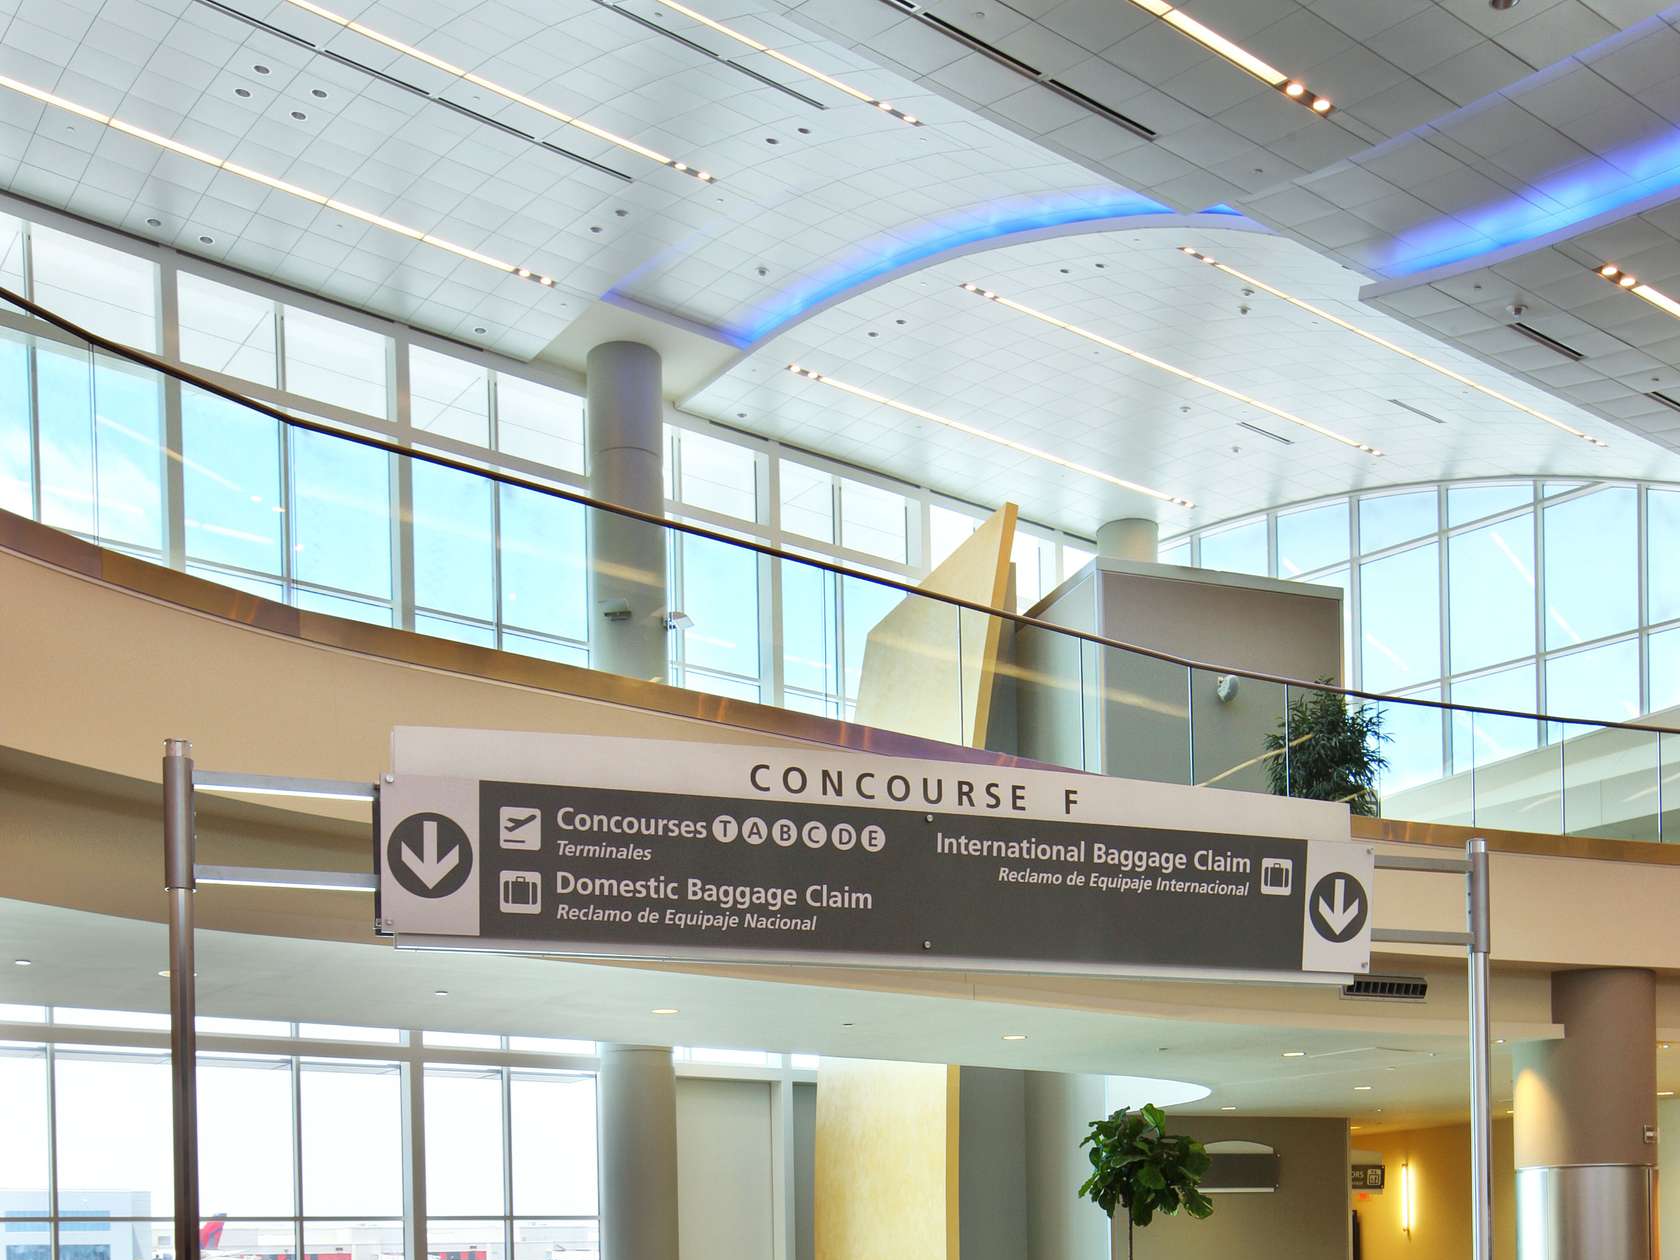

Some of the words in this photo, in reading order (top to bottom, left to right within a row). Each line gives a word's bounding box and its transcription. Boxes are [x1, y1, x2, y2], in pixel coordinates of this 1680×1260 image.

[750, 763, 1026, 812] CONCOURSE
[1064, 789, 1079, 815] F
[556, 806, 708, 839] Concourses
[556, 840, 652, 861] Terminales
[936, 832, 1085, 863] International
[1093, 842, 1187, 874] Baggage
[1193, 849, 1251, 874] Claim
[556, 871, 679, 900] Domestic
[687, 878, 798, 911] Baggage
[805, 884, 873, 909] Claim
[998, 867, 1063, 885] Reclamo
[1066, 870, 1086, 886] de
[1089, 872, 1153, 894] Equipaje
[1156, 877, 1250, 896] Internacional
[556, 904, 633, 922] Reclamo
[637, 907, 660, 924] de
[664, 909, 739, 931] Equipaje
[743, 913, 817, 931] Nacional
